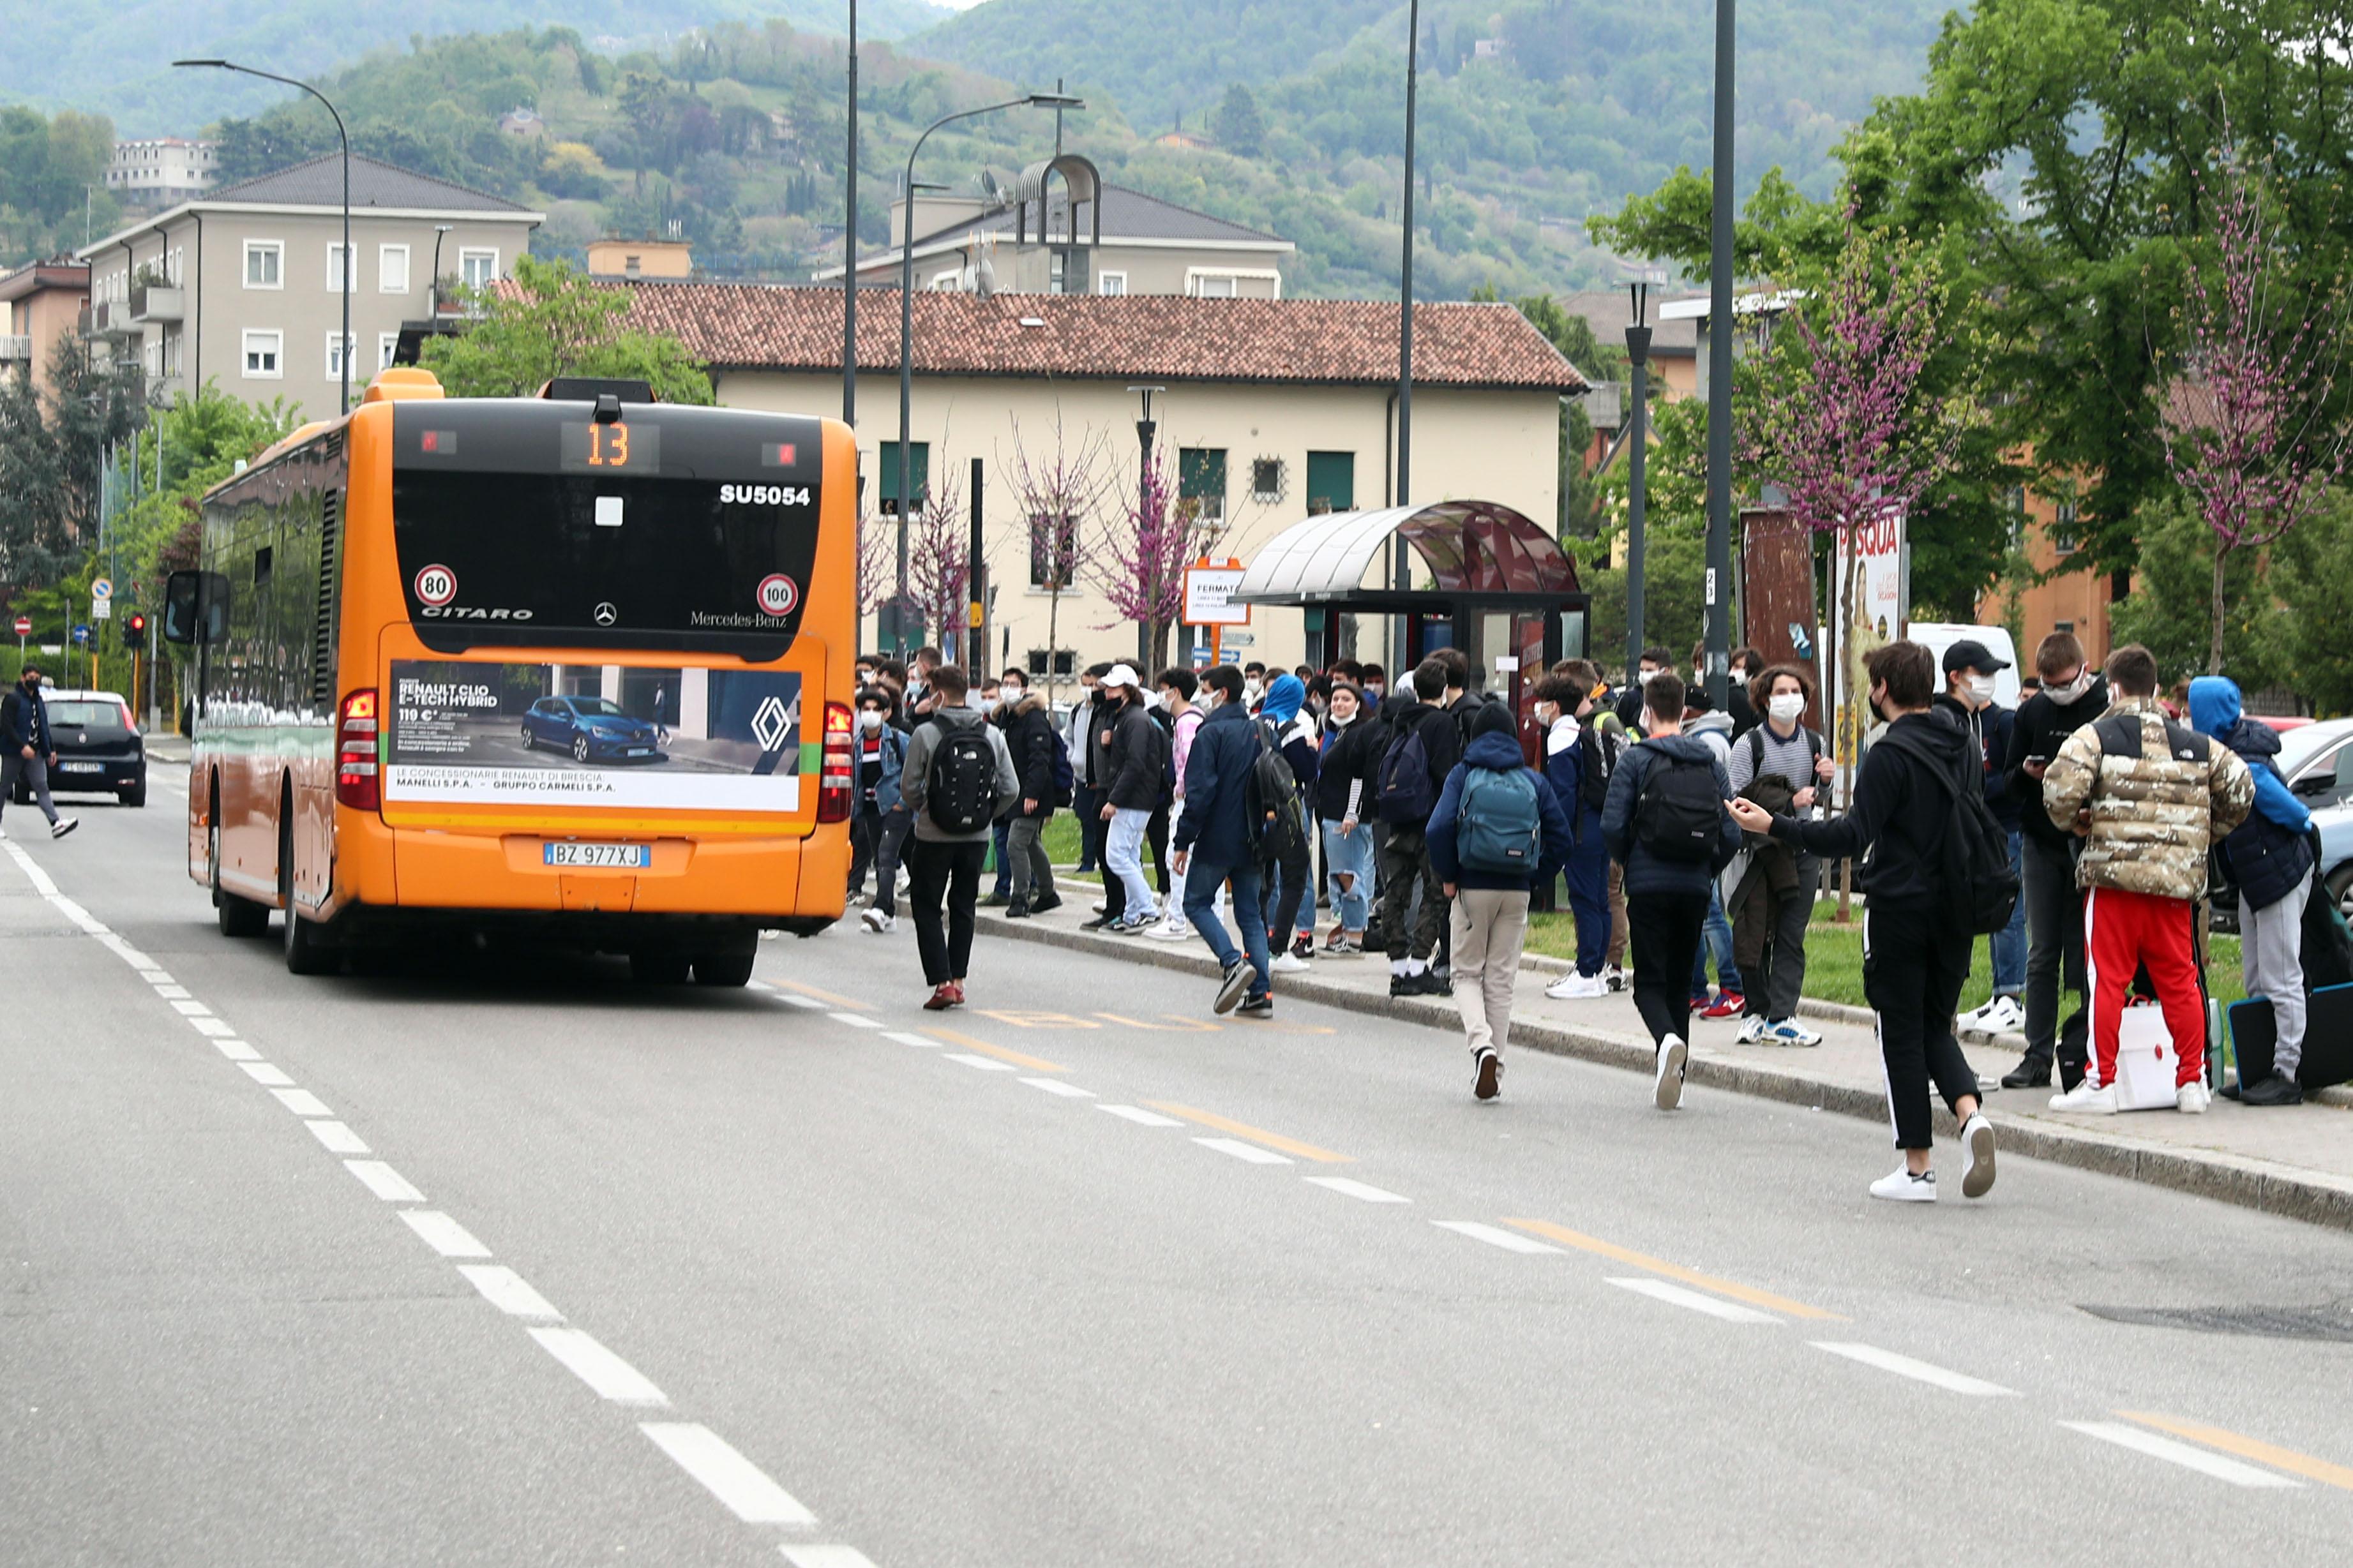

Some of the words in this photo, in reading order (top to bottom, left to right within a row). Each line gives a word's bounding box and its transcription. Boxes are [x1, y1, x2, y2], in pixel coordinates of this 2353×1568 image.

[589, 422, 628, 466] 13
[720, 484, 811, 506] SU5054
[1838, 517, 1897, 557] PSQUA
[425, 576, 447, 594] 80
[767, 588, 789, 602] 100
[421, 607, 533, 620] CITARO
[691, 611, 786, 628] Mercedes-Benz
[399, 683, 456, 695] RENAULT
[458, 685, 489, 696] CLIO
[399, 694, 447, 706] E-TECH
[449, 695, 498, 708] HYBRID
[396, 768, 405, 777] LE
[409, 768, 497, 779] CONCESSIONARIE
[502, 770, 545, 780] RENAULT
[548, 772, 558, 780] DI
[396, 778, 440, 788] MANELLI
[443, 779, 473, 789] S.P.A.
[493, 780, 536, 790] GRUPPO
[539, 782, 584, 791] CARMELI
[587, 783, 616, 793] S.P.A.
[556, 846, 577, 863] BZ
[584, 846, 638, 865] 977XJ
